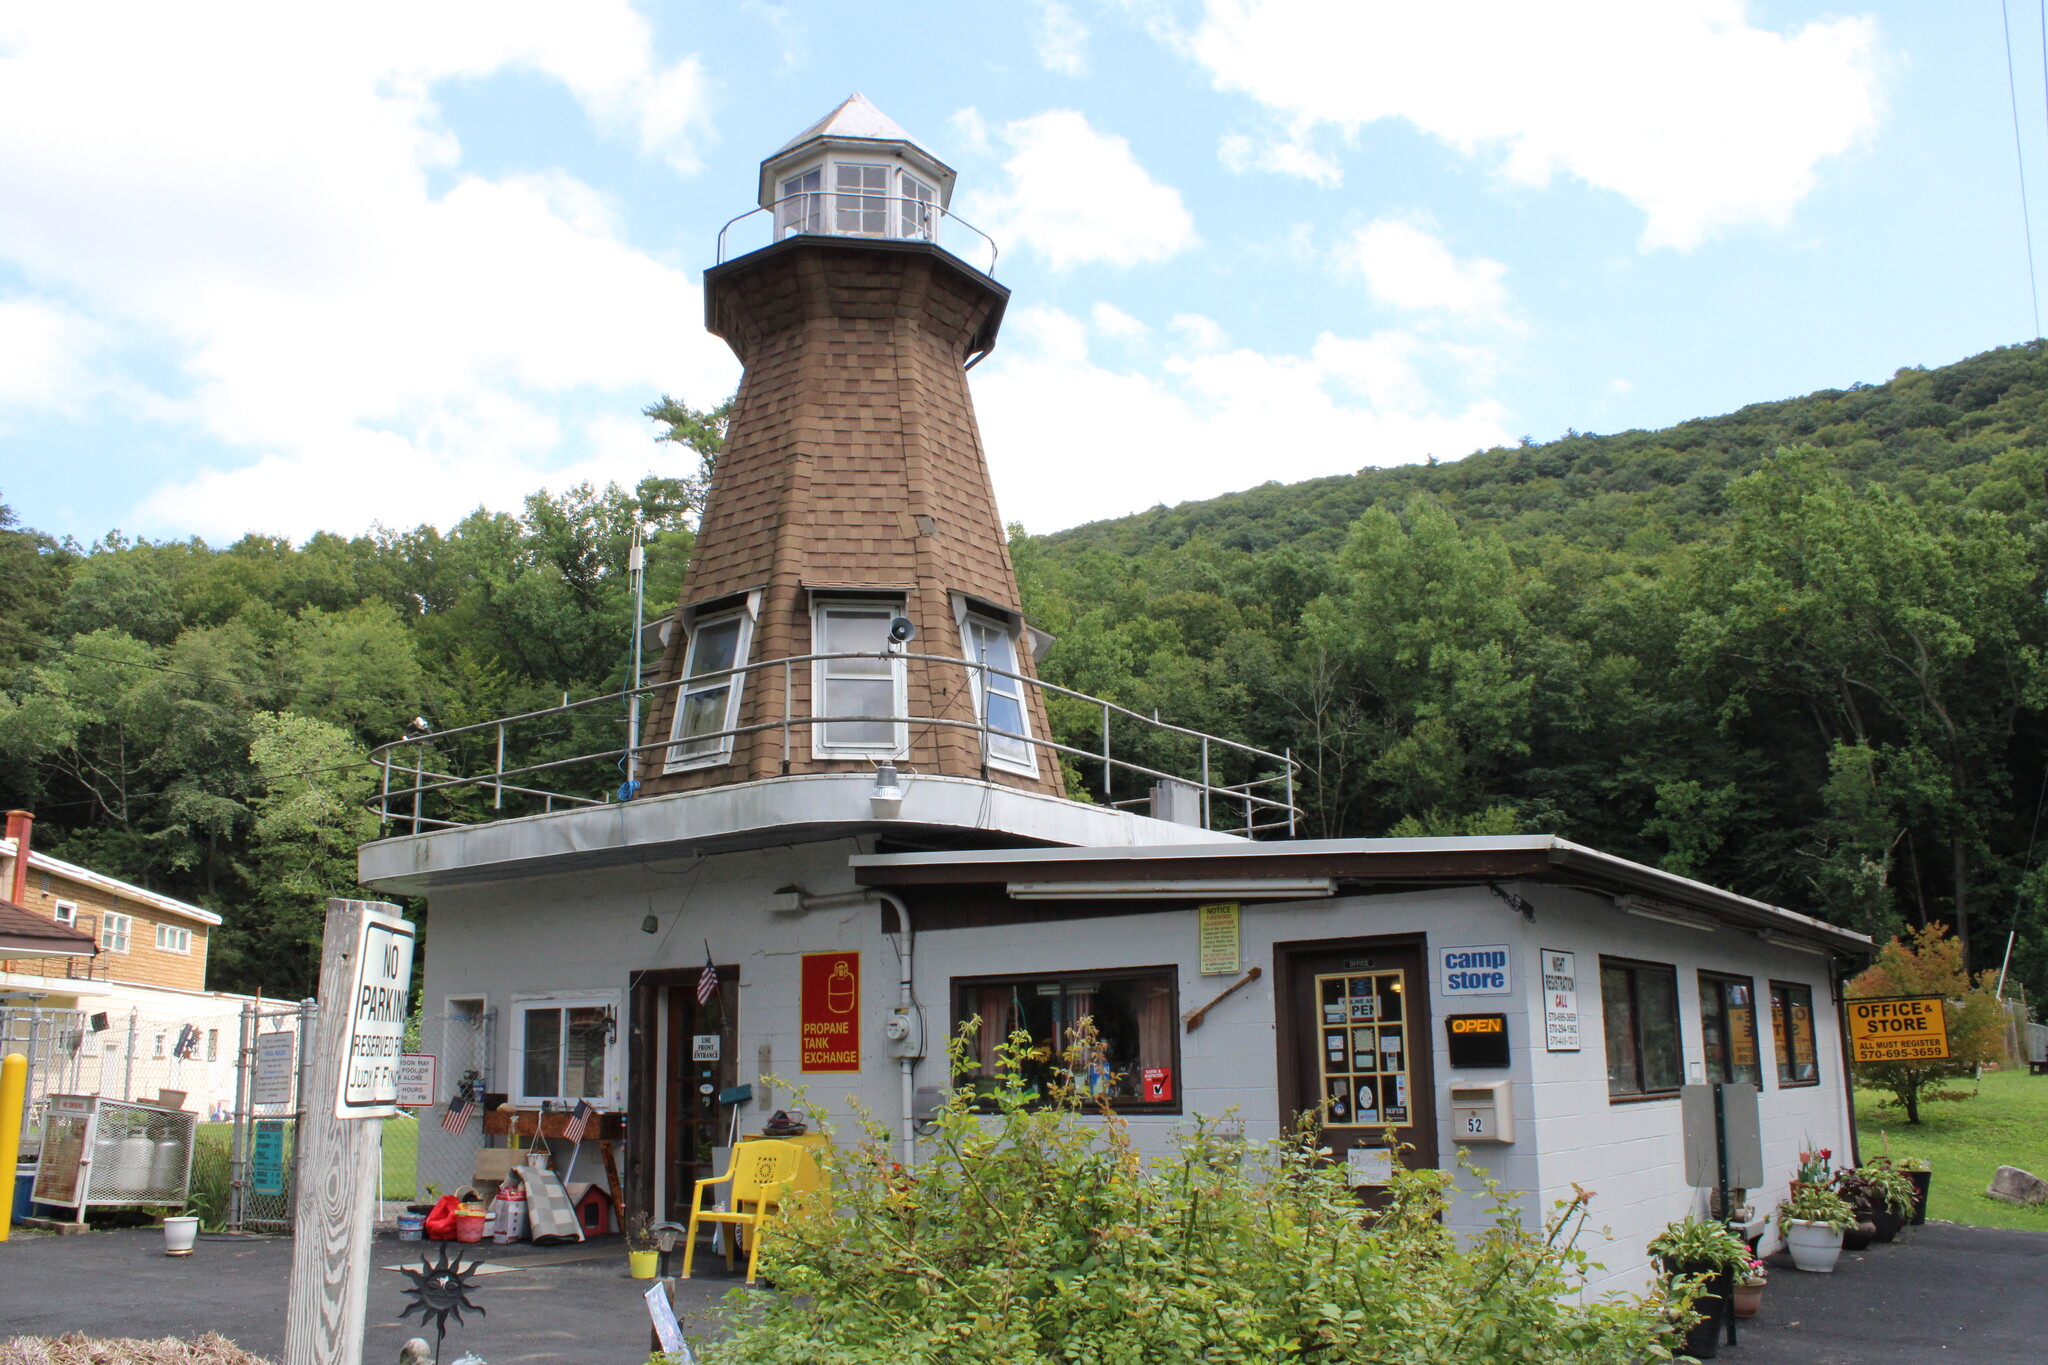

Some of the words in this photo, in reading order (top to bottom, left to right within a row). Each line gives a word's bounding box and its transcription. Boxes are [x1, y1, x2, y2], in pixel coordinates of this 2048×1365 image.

[1206, 906, 1231, 914] NOTICE
[383, 944, 399, 980] NO
[1445, 950, 1506, 969] camp
[1448, 971, 1504, 990] store
[1545, 974, 1575, 992] REGISTRATION
[1555, 994, 1568, 1008] CALL
[1858, 1002, 1922, 1018] OFFICE
[1924, 1004, 1933, 1012] &
[804, 1022, 849, 1034] PROPANE
[1452, 1018, 1502, 1033] OPEN
[1868, 1017, 1928, 1033] STORE
[352, 1035, 394, 1056] RESERVED
[804, 1037, 829, 1049] TANK
[1860, 1042, 1874, 1050] ALL
[1876, 1041, 1898, 1049] MUST
[1901, 1038, 1941, 1048] REGISTER
[804, 1051, 857, 1063] EXCHANGE
[1860, 1047, 1942, 1059] 570-695-3659
[1468, 1118, 1482, 1132] 52
